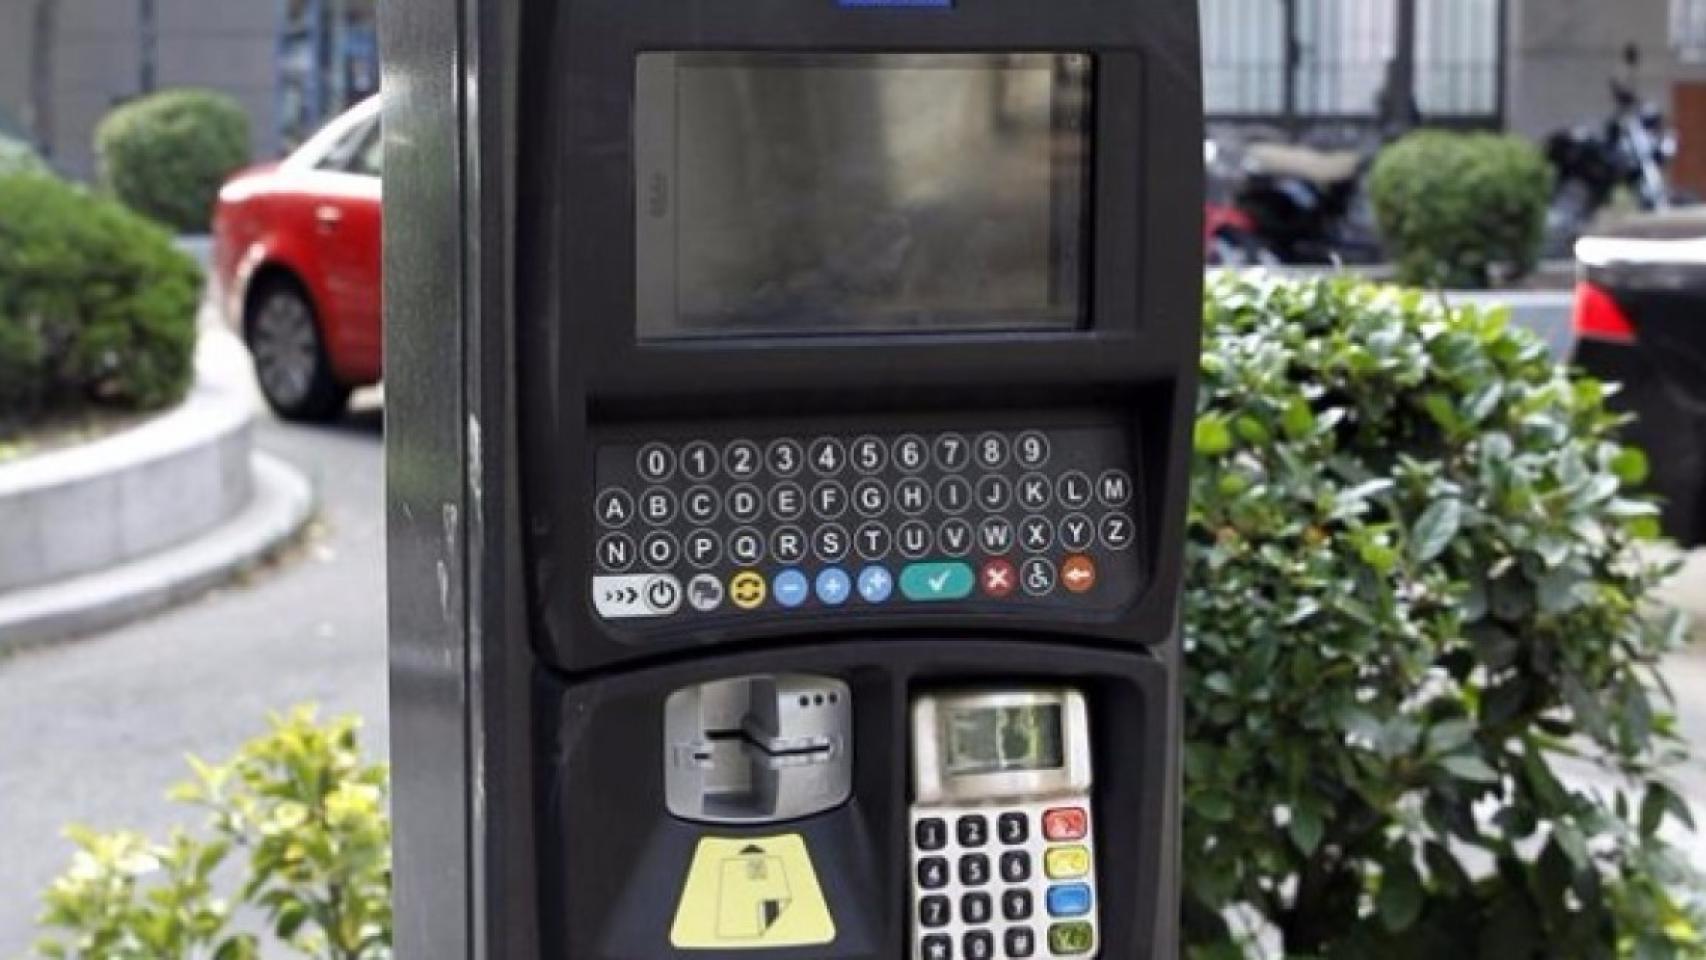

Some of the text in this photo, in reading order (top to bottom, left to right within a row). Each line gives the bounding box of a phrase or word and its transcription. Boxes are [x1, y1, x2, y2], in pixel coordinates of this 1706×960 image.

[693, 450, 705, 473] 1
[734, 447, 750, 473] 2
[778, 445, 793, 471] 3
[818, 444, 836, 469] 4
[862, 443, 878, 468] 5
[902, 441, 919, 466] 6
[944, 440, 959, 464] 7
[984, 439, 1000, 463] 8
[1024, 437, 1040, 462] 9
[606, 498, 624, 519] A
[649, 495, 668, 517] B
[692, 494, 710, 516] C
[735, 492, 753, 513] D
[778, 490, 795, 513] E
[822, 488, 836, 510] F
[861, 487, 882, 509] G
[904, 487, 922, 507] H
[987, 483, 1000, 503] J
[1026, 481, 1043, 503] K
[1067, 480, 1082, 500] L
[1104, 479, 1123, 499] M
[608, 541, 625, 564] N
[694, 538, 712, 559] P
[735, 535, 756, 558] Q
[780, 535, 798, 555] R
[823, 532, 839, 554] S
[865, 530, 881, 551] T
[906, 529, 923, 551] U
[947, 528, 964, 548] V
[983, 525, 1008, 546] W
[1028, 524, 1045, 544] X
[1067, 522, 1084, 543] Y
[1108, 520, 1124, 541] Z
